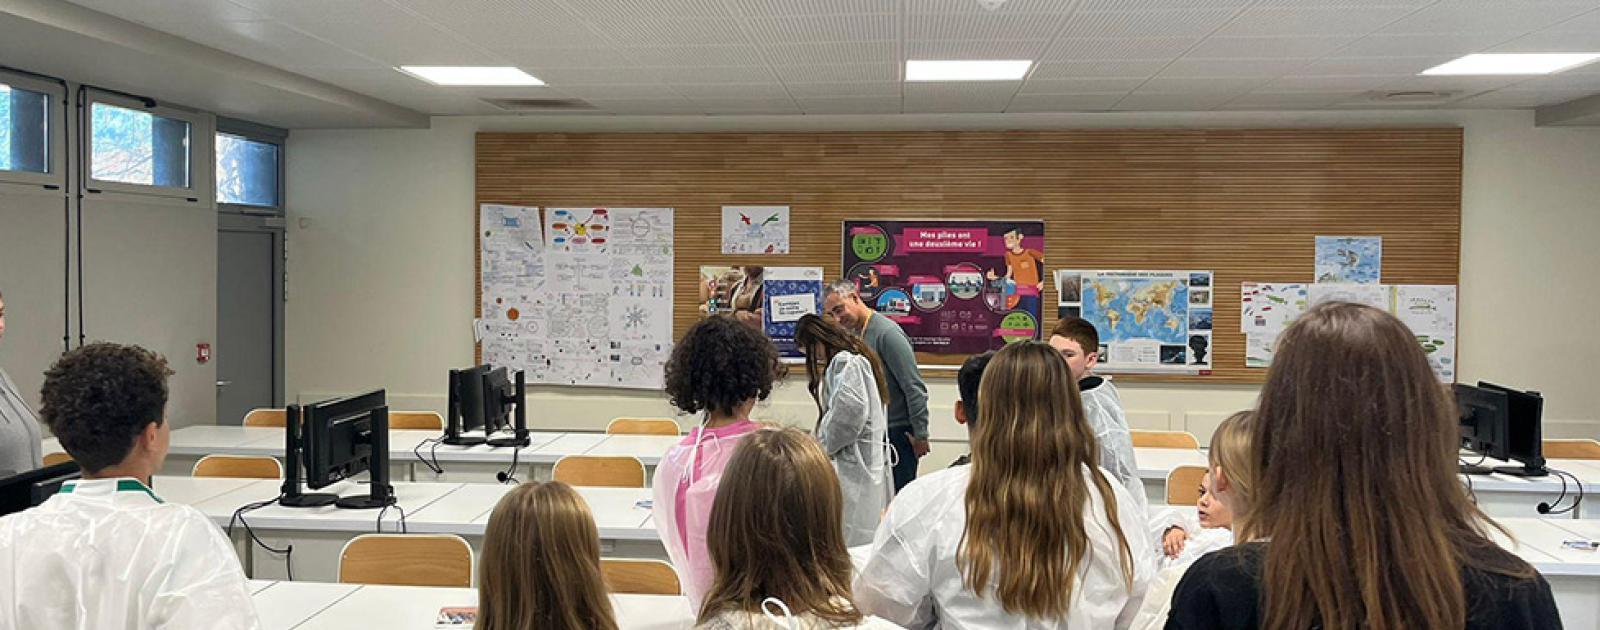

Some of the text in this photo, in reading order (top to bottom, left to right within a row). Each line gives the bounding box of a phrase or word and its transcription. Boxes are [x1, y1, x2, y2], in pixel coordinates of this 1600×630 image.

[920, 231, 936, 239] Mes
[937, 230, 956, 240] piles
[908, 240, 924, 248] une
[925, 240, 964, 248] deuxième
[964, 240, 977, 248] vie
